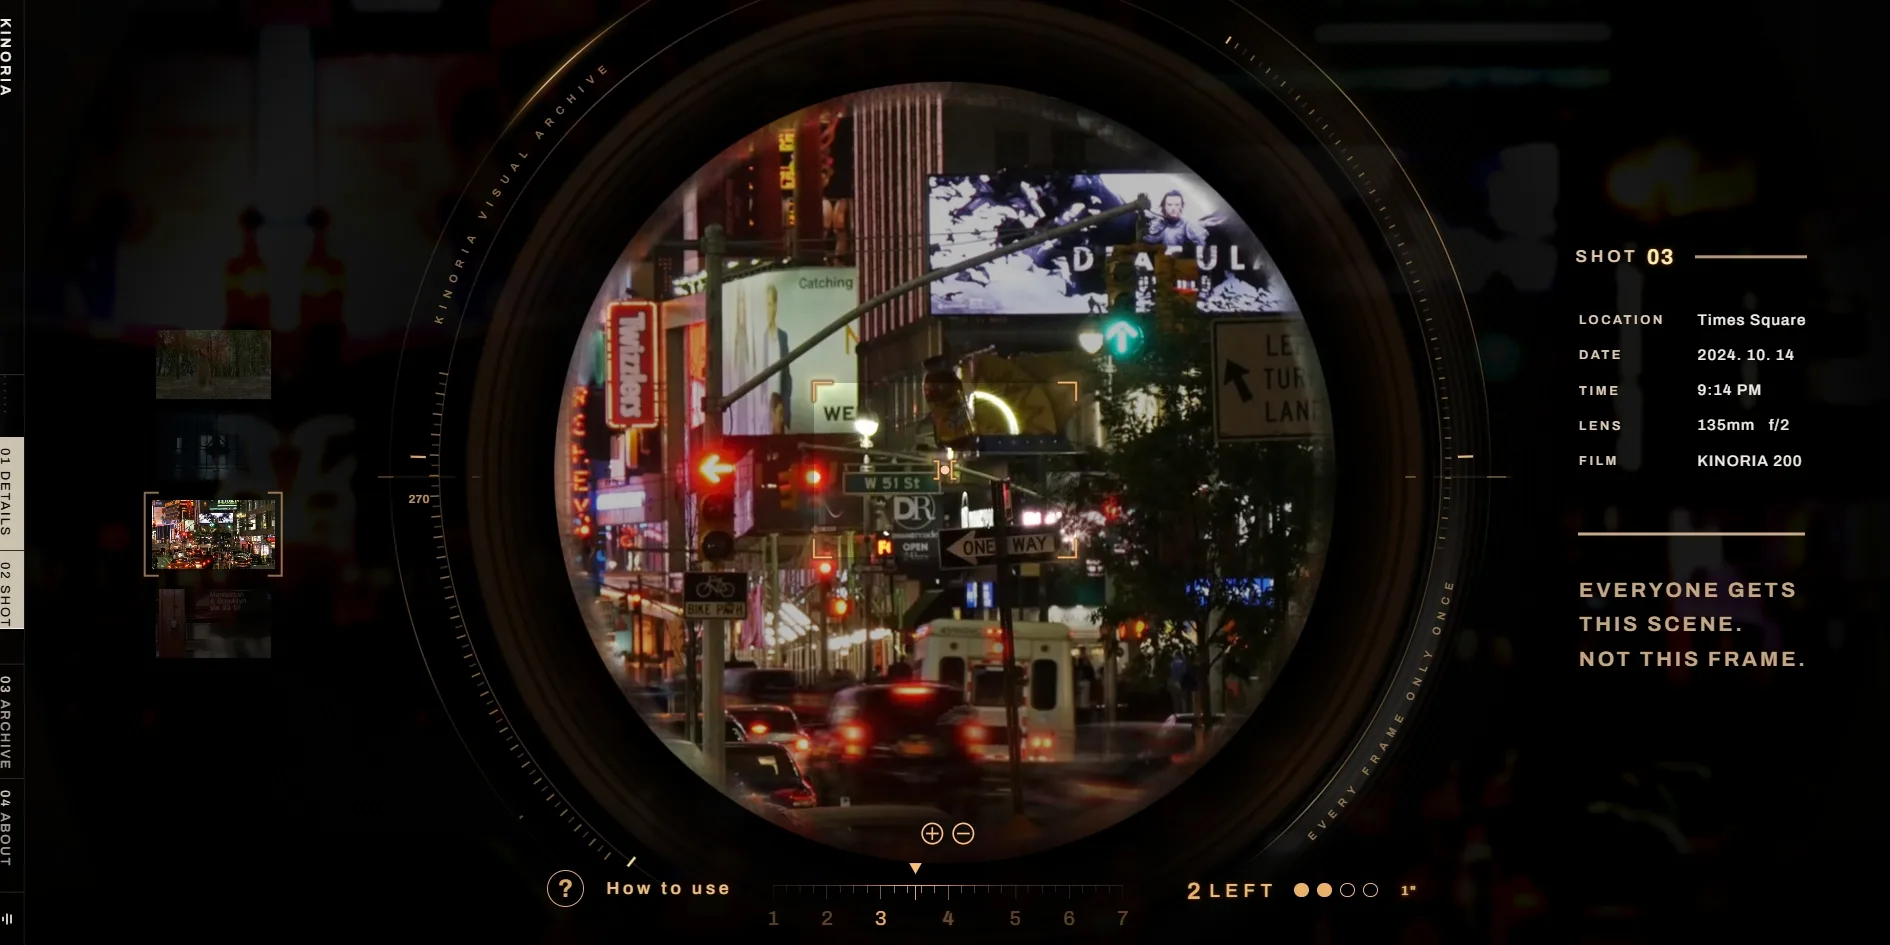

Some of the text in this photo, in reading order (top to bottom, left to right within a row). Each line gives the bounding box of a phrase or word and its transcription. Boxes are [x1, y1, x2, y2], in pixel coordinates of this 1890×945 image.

[798, 276, 854, 292] Catching
[618, 310, 648, 419] Twizzlers
[823, 405, 855, 422] WE
[864, 477, 921, 490] W 51 St
[902, 542, 929, 552] OPEN
[963, 537, 1046, 556] ONE WAY
[687, 604, 711, 615] BIKE
